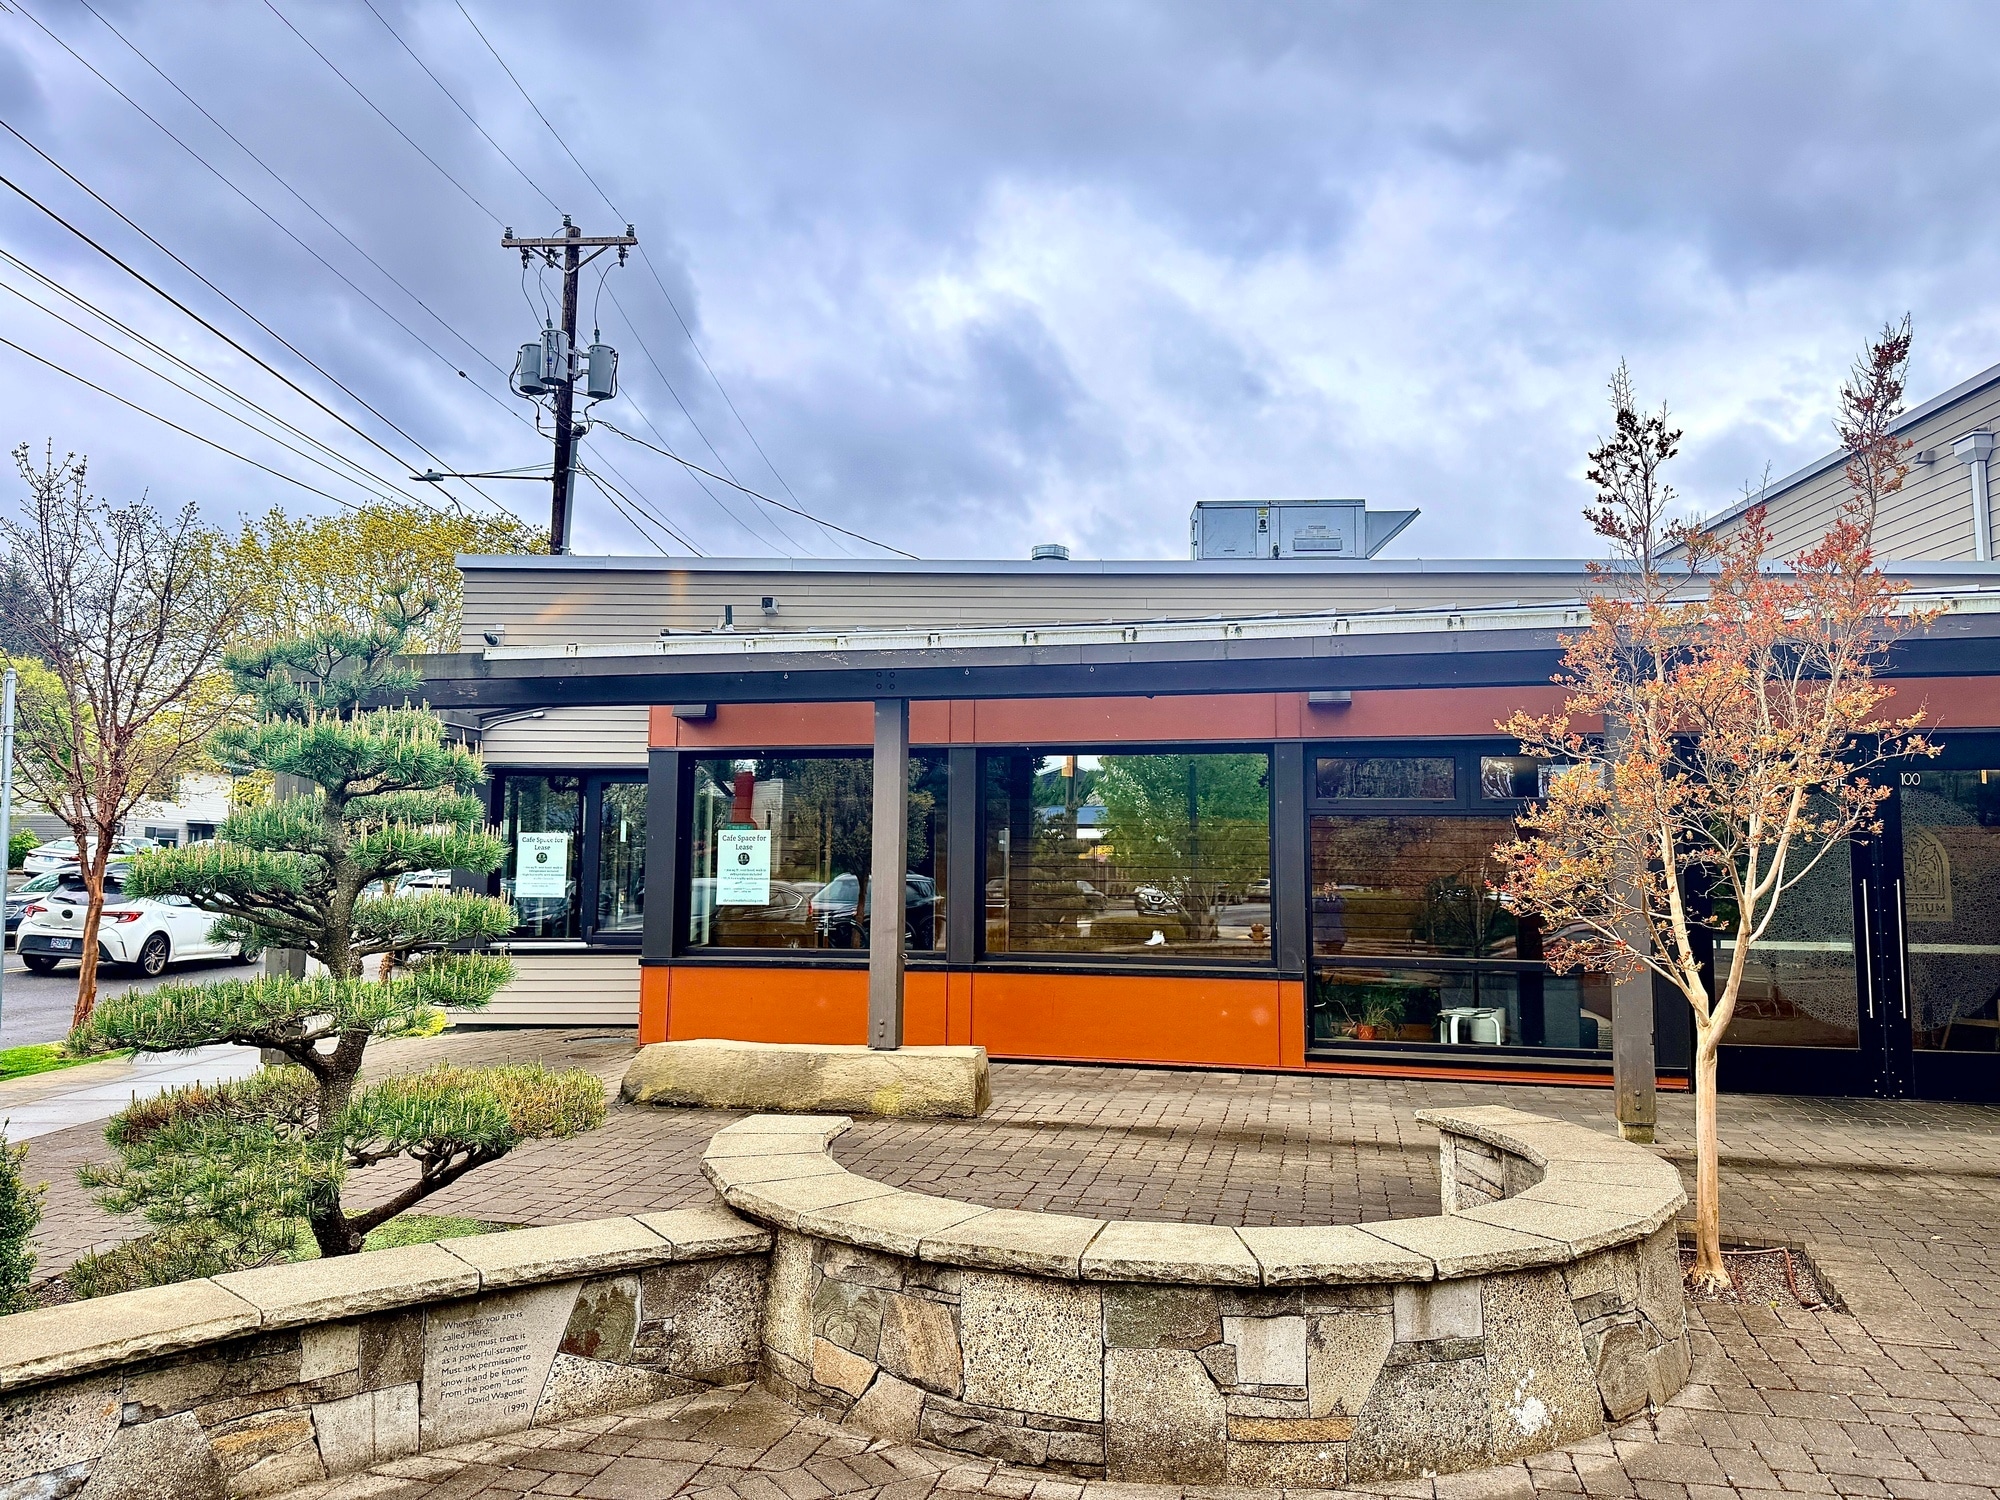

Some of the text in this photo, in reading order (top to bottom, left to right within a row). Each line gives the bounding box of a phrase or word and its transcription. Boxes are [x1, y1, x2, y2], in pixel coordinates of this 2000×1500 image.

[1900, 772, 1921, 786] 100
[737, 834, 756, 843] Space
[443, 1317, 484, 1329] Wherever
[486, 1315, 500, 1325] you
[502, 1313, 515, 1321] are
[442, 1330, 466, 1342] called
[442, 1343, 459, 1353] And
[461, 1341, 476, 1351] you
[478, 1338, 497, 1347] must
[499, 1334, 519, 1343] treat
[441, 1357, 450, 1365] as
[459, 1347, 494, 1364] powerful
[441, 1367, 461, 1376] Must
[463, 1362, 477, 1372] ask
[478, 1356, 521, 1371] permission
[440, 1378, 463, 1387] know
[472, 1371, 488, 1382] and
[489, 1371, 500, 1380] be
[440, 1389, 462, 1400] From
[464, 1386, 478, 1395] the
[479, 1382, 502, 1393] poem
[467, 1388, 527, 1405] David Wagoner
[503, 1402, 529, 1415] (1999)
